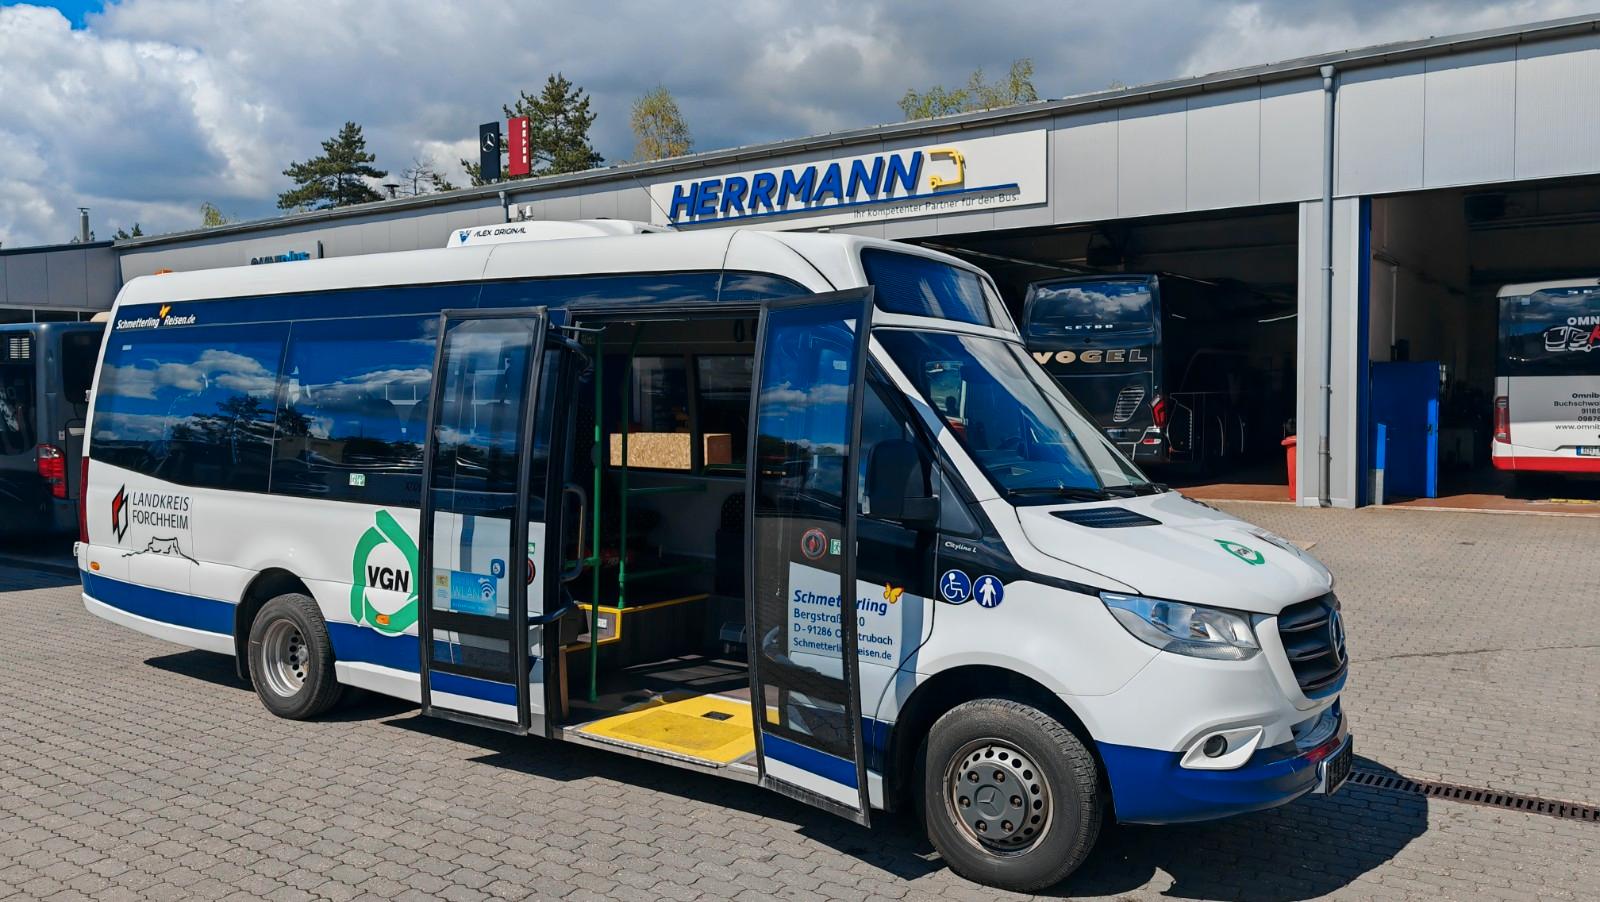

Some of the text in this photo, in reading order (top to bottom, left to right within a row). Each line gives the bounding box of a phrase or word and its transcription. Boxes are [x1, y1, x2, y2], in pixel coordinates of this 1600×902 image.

[669, 151, 922, 220] HERRMANN
[854, 209, 865, 219] Ihr
[868, 204, 921, 219] kompetenter
[925, 200, 958, 212] Partner
[962, 197, 974, 206] für
[978, 195, 995, 205] den
[494, 227, 526, 236] ORIGINAL
[116, 314, 196, 330] Schmetterling Reisen.de
[1033, 349, 1148, 364] VOGEL
[132, 492, 190, 511] LANDKREIS
[132, 509, 188, 530] FORCHHEIM
[368, 565, 409, 592] VGN
[794, 590, 888, 615] Schmetrling
[794, 608, 843, 624] Bergstraß
[835, 629, 893, 645] Otrubach
